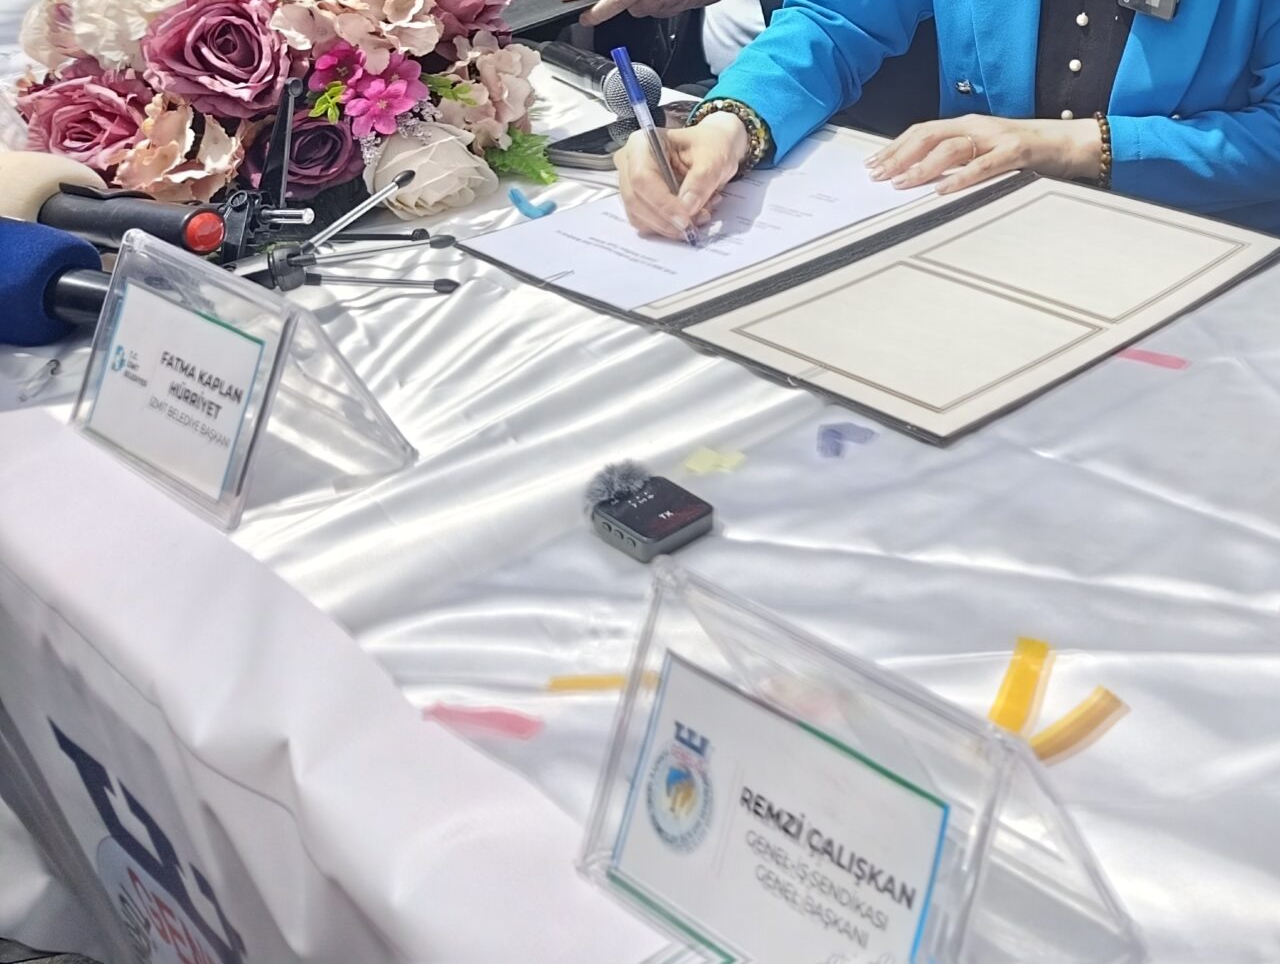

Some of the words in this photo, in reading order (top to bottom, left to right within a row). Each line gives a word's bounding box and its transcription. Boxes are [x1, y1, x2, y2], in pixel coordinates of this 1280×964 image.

[160, 351, 197, 382] FATMA
[197, 370, 244, 405] KAPLAN
[168, 381, 223, 420] HÜRRİYET
[739, 786, 806, 842] REMZİ
[806, 828, 916, 910] ÇALIŞKAN
[755, 864, 801, 907] GENEL
[802, 895, 869, 950] BAŞKANI
[809, 870, 889, 932] SENDİKASI
